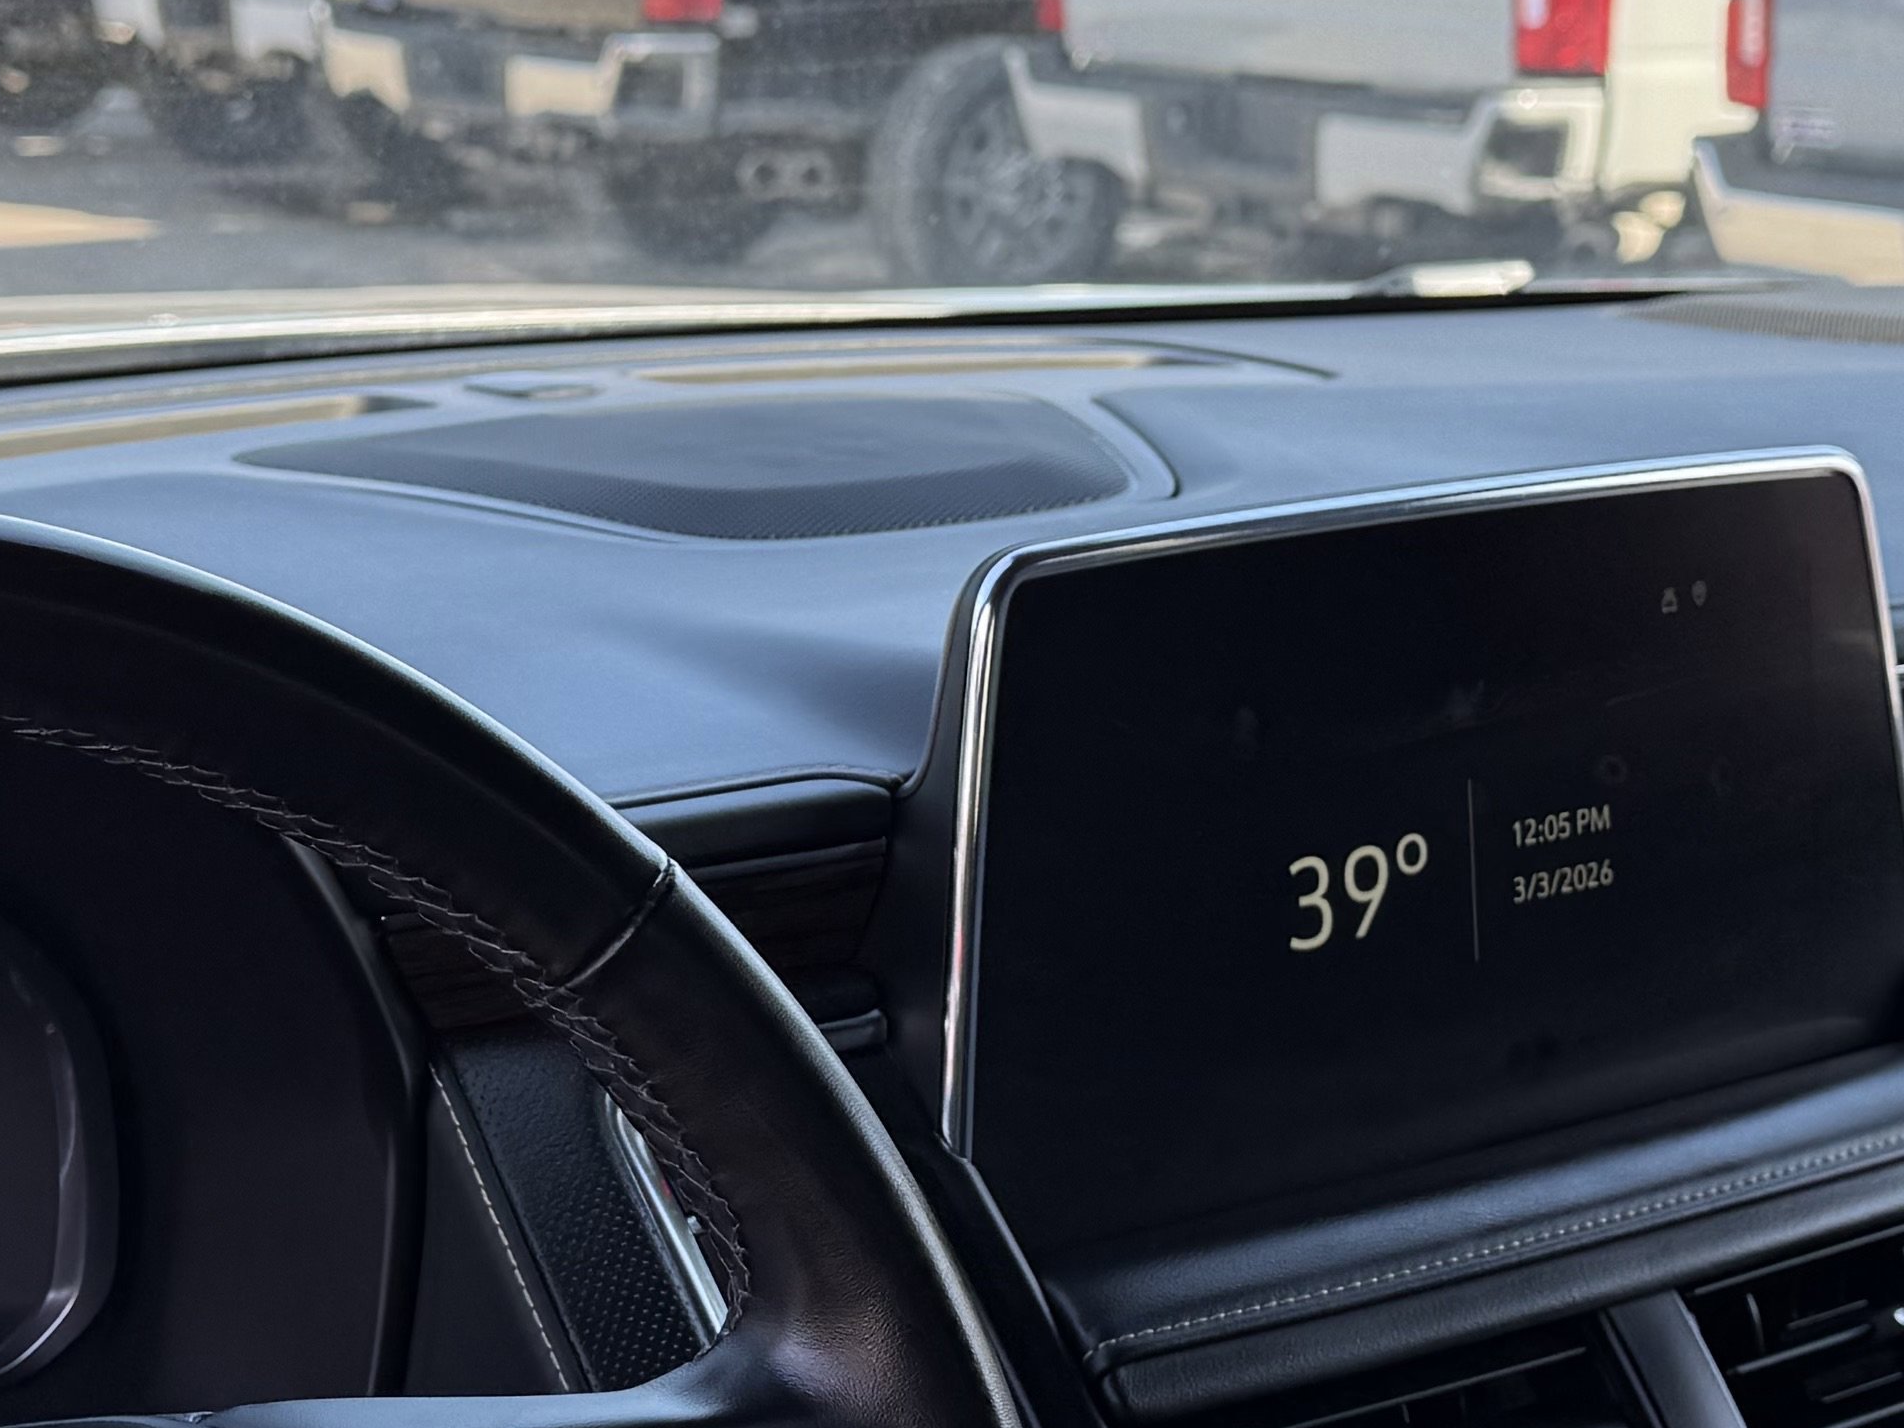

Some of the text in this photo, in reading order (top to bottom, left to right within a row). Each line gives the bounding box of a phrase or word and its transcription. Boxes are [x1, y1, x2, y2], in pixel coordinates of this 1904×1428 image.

[1512, 804, 1611, 847] 12:05 PM
[1513, 859, 1614, 904] 3/3/2026
